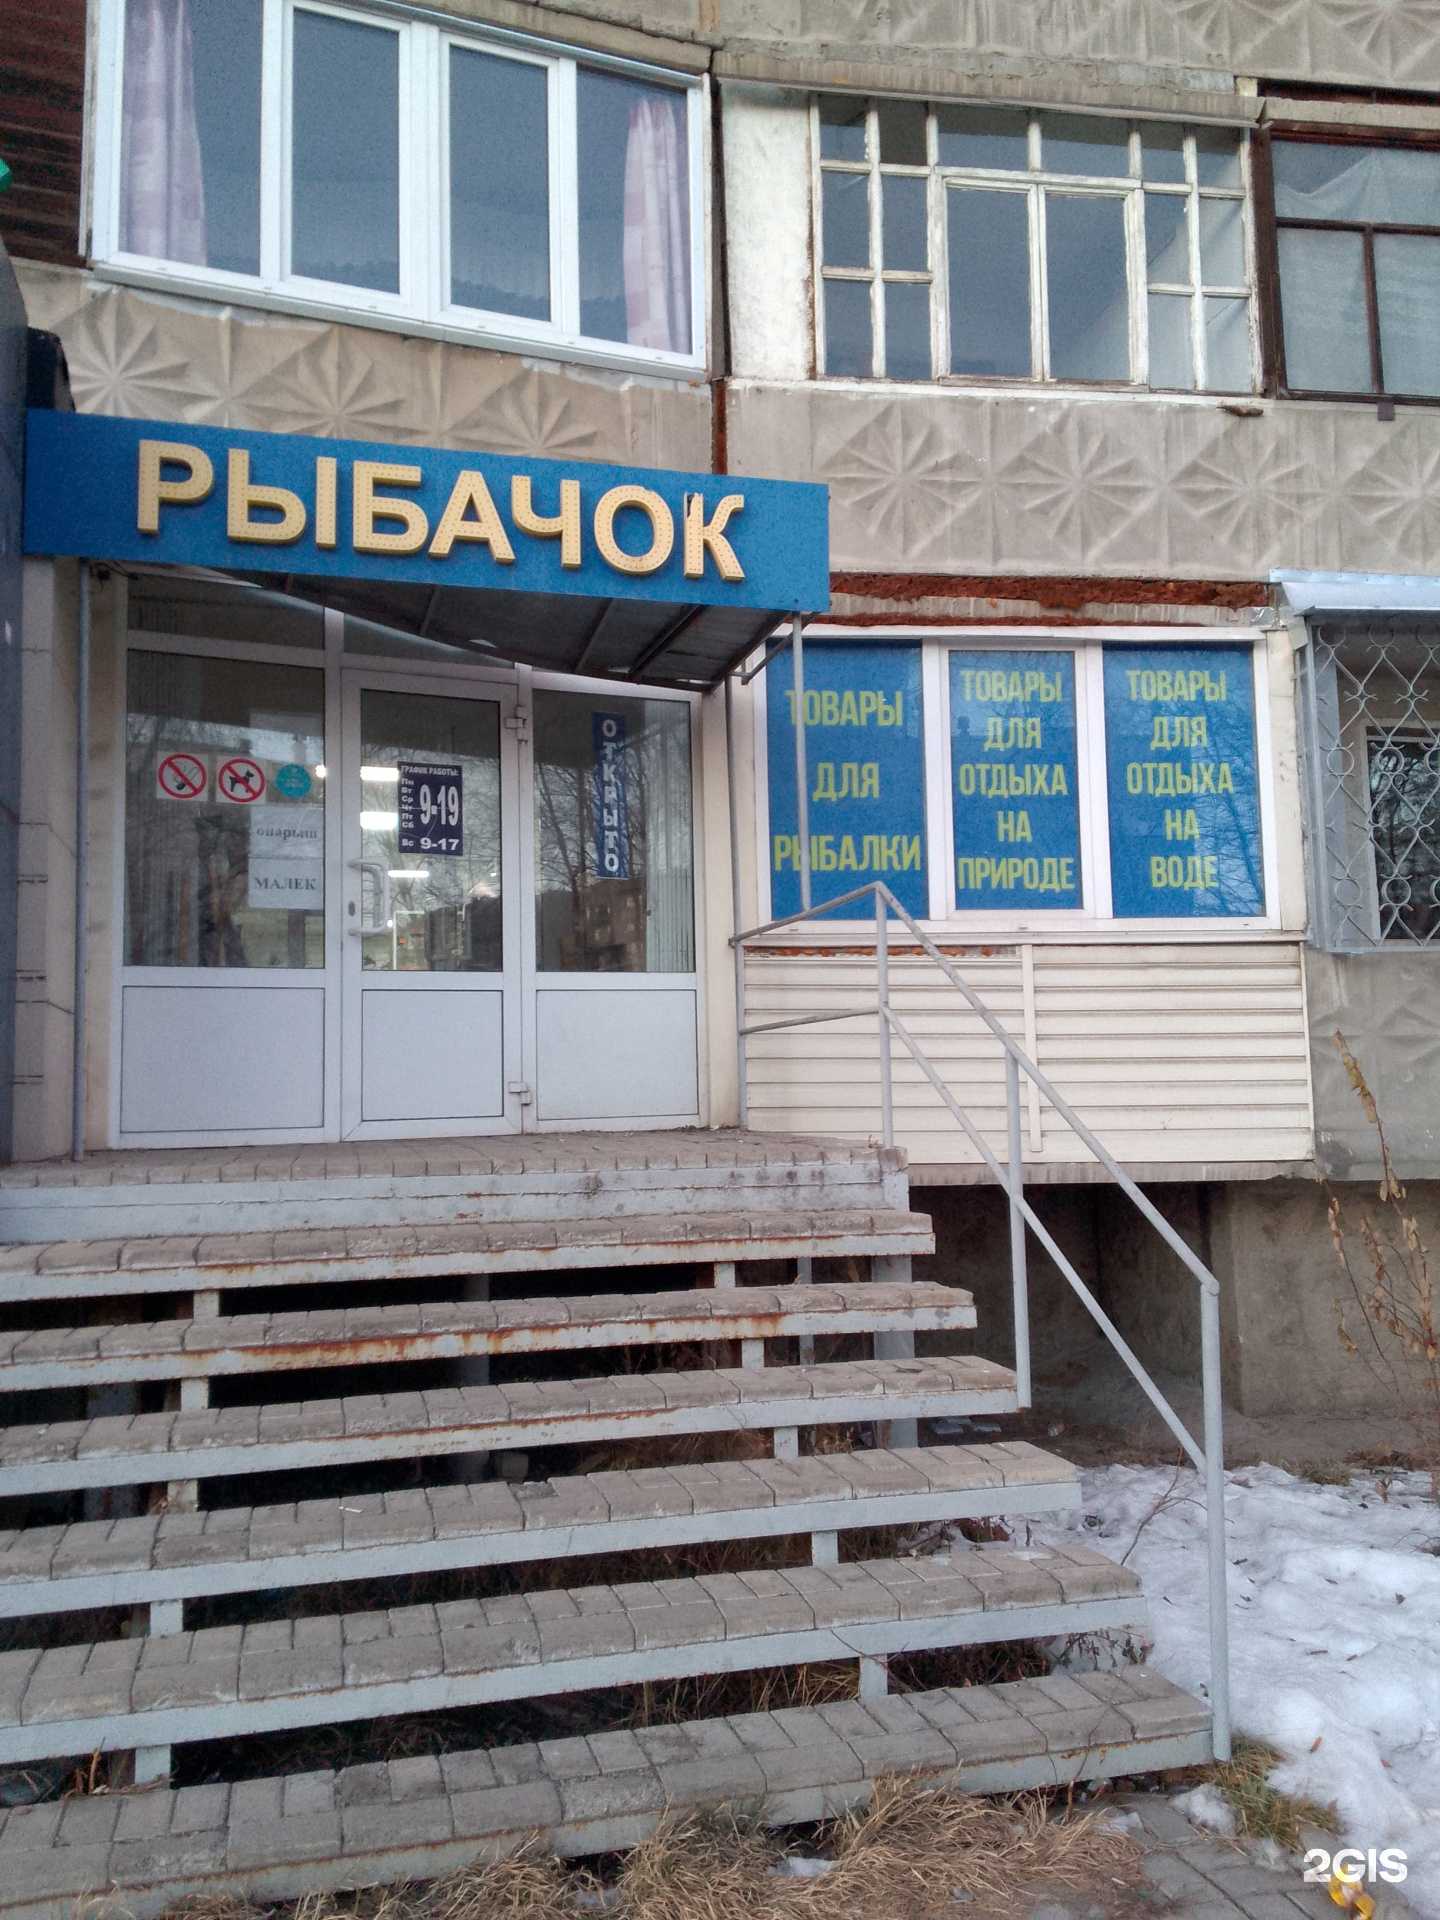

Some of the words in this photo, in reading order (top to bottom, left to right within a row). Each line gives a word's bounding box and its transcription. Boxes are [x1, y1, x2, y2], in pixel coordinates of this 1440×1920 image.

[136, 438, 746, 582] РЫБАЧОК
[956, 670, 1063, 703] ТОВАРЫ
[1126, 669, 1228, 702] ТОВАРЫ
[784, 689, 904, 727] ТОВАРЫ
[984, 716, 1043, 752] ДЛЯ
[1150, 715, 1209, 751] ДЛЯ
[602, 719, 620, 873] ОТКРЫТО
[812, 762, 880, 802] ДЛЯ
[958, 763, 1069, 799] ОТДЫХА
[1126, 762, 1234, 798] ОТДЫХА
[419, 784, 459, 826] 9-19
[996, 810, 1033, 843] НА
[1163, 808, 1201, 841] НА
[420, 837, 460, 852] 9-17
[773, 834, 921, 873] РЫБАЛКИ
[254, 877, 317, 892] МАЛЕК
[957, 857, 1076, 894] ПРИРОДЕ
[1151, 856, 1220, 891] ВОДЕ
